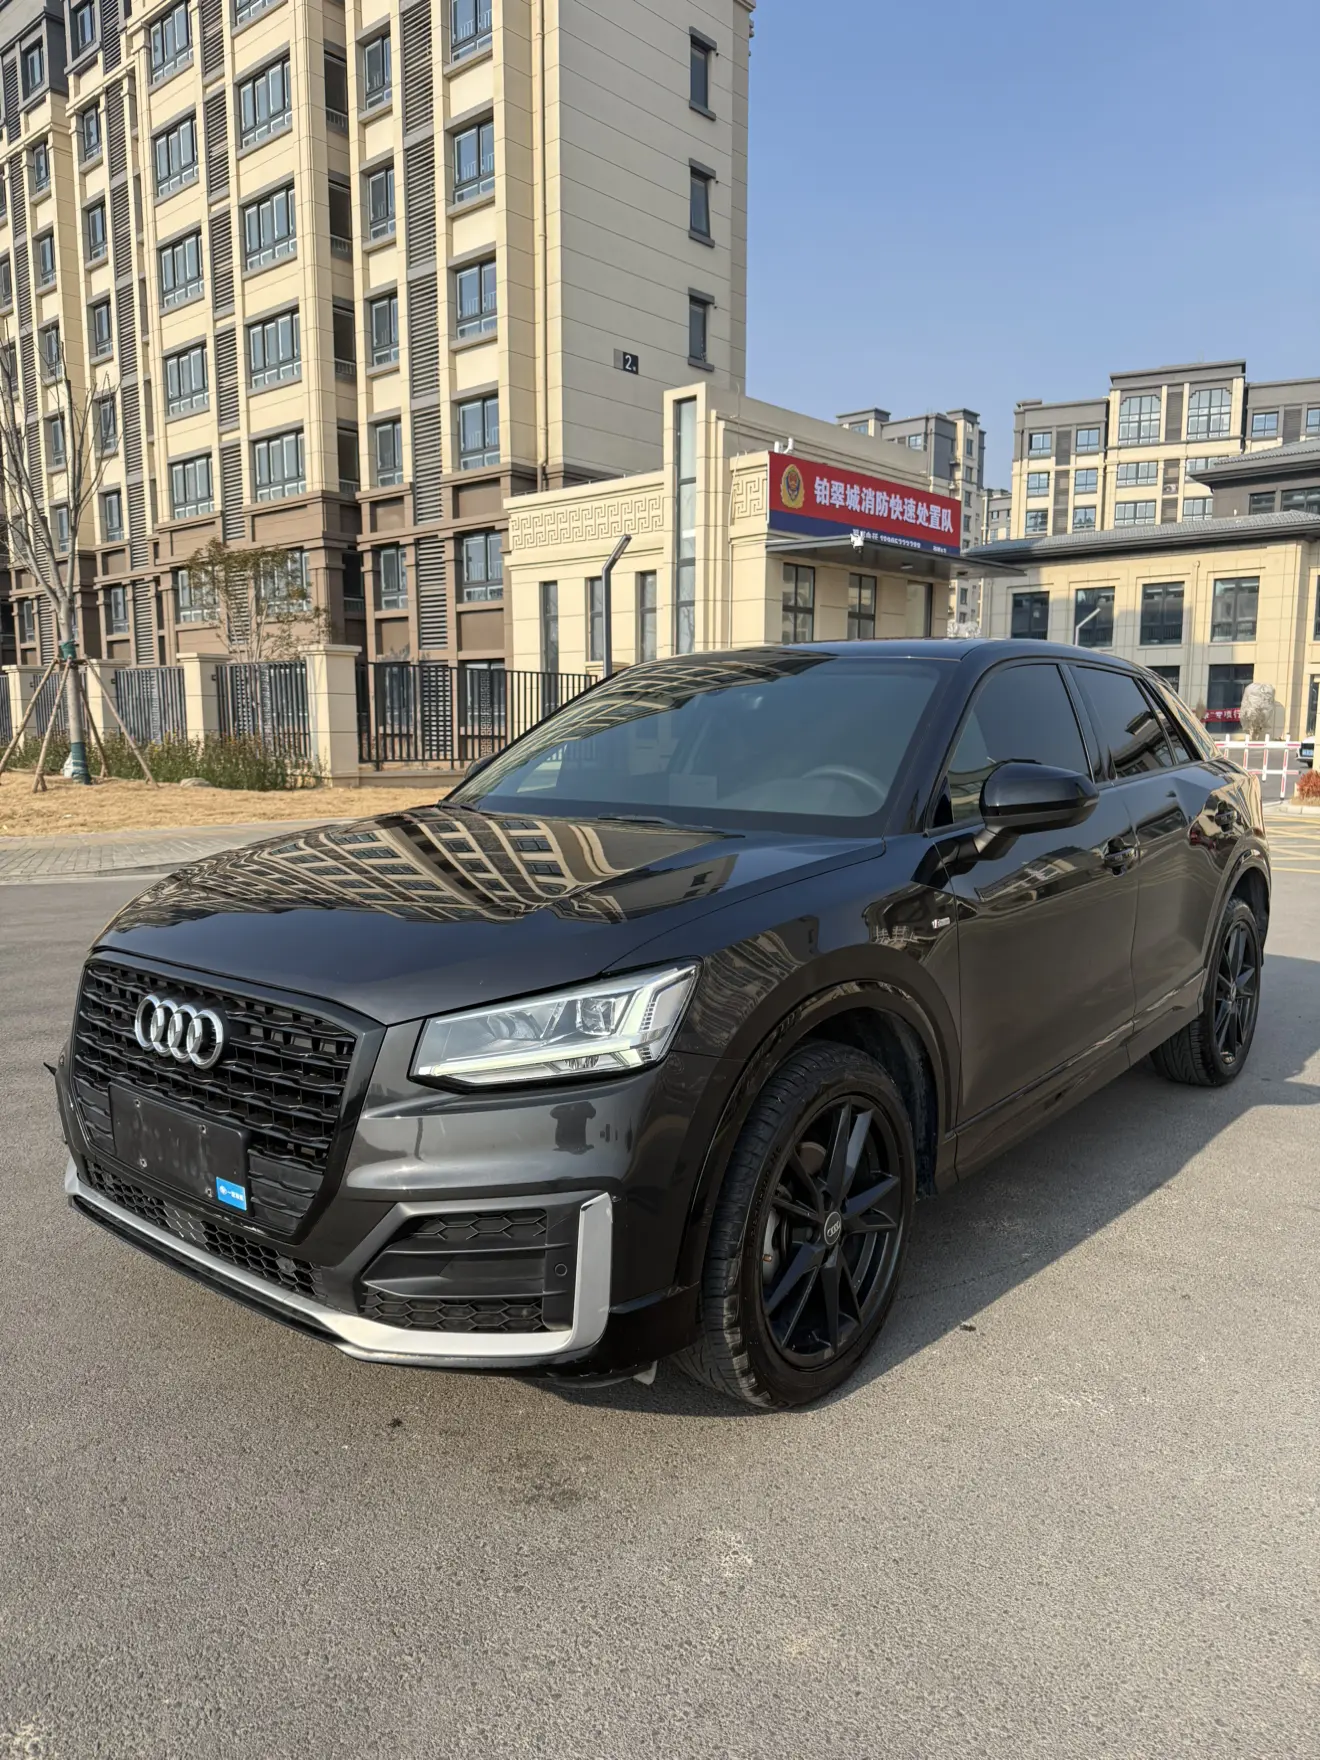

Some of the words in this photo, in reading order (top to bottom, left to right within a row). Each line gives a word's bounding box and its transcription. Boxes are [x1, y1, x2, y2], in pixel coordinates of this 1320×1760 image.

[814, 476, 954, 533] 铂翠城消防快速处置队
